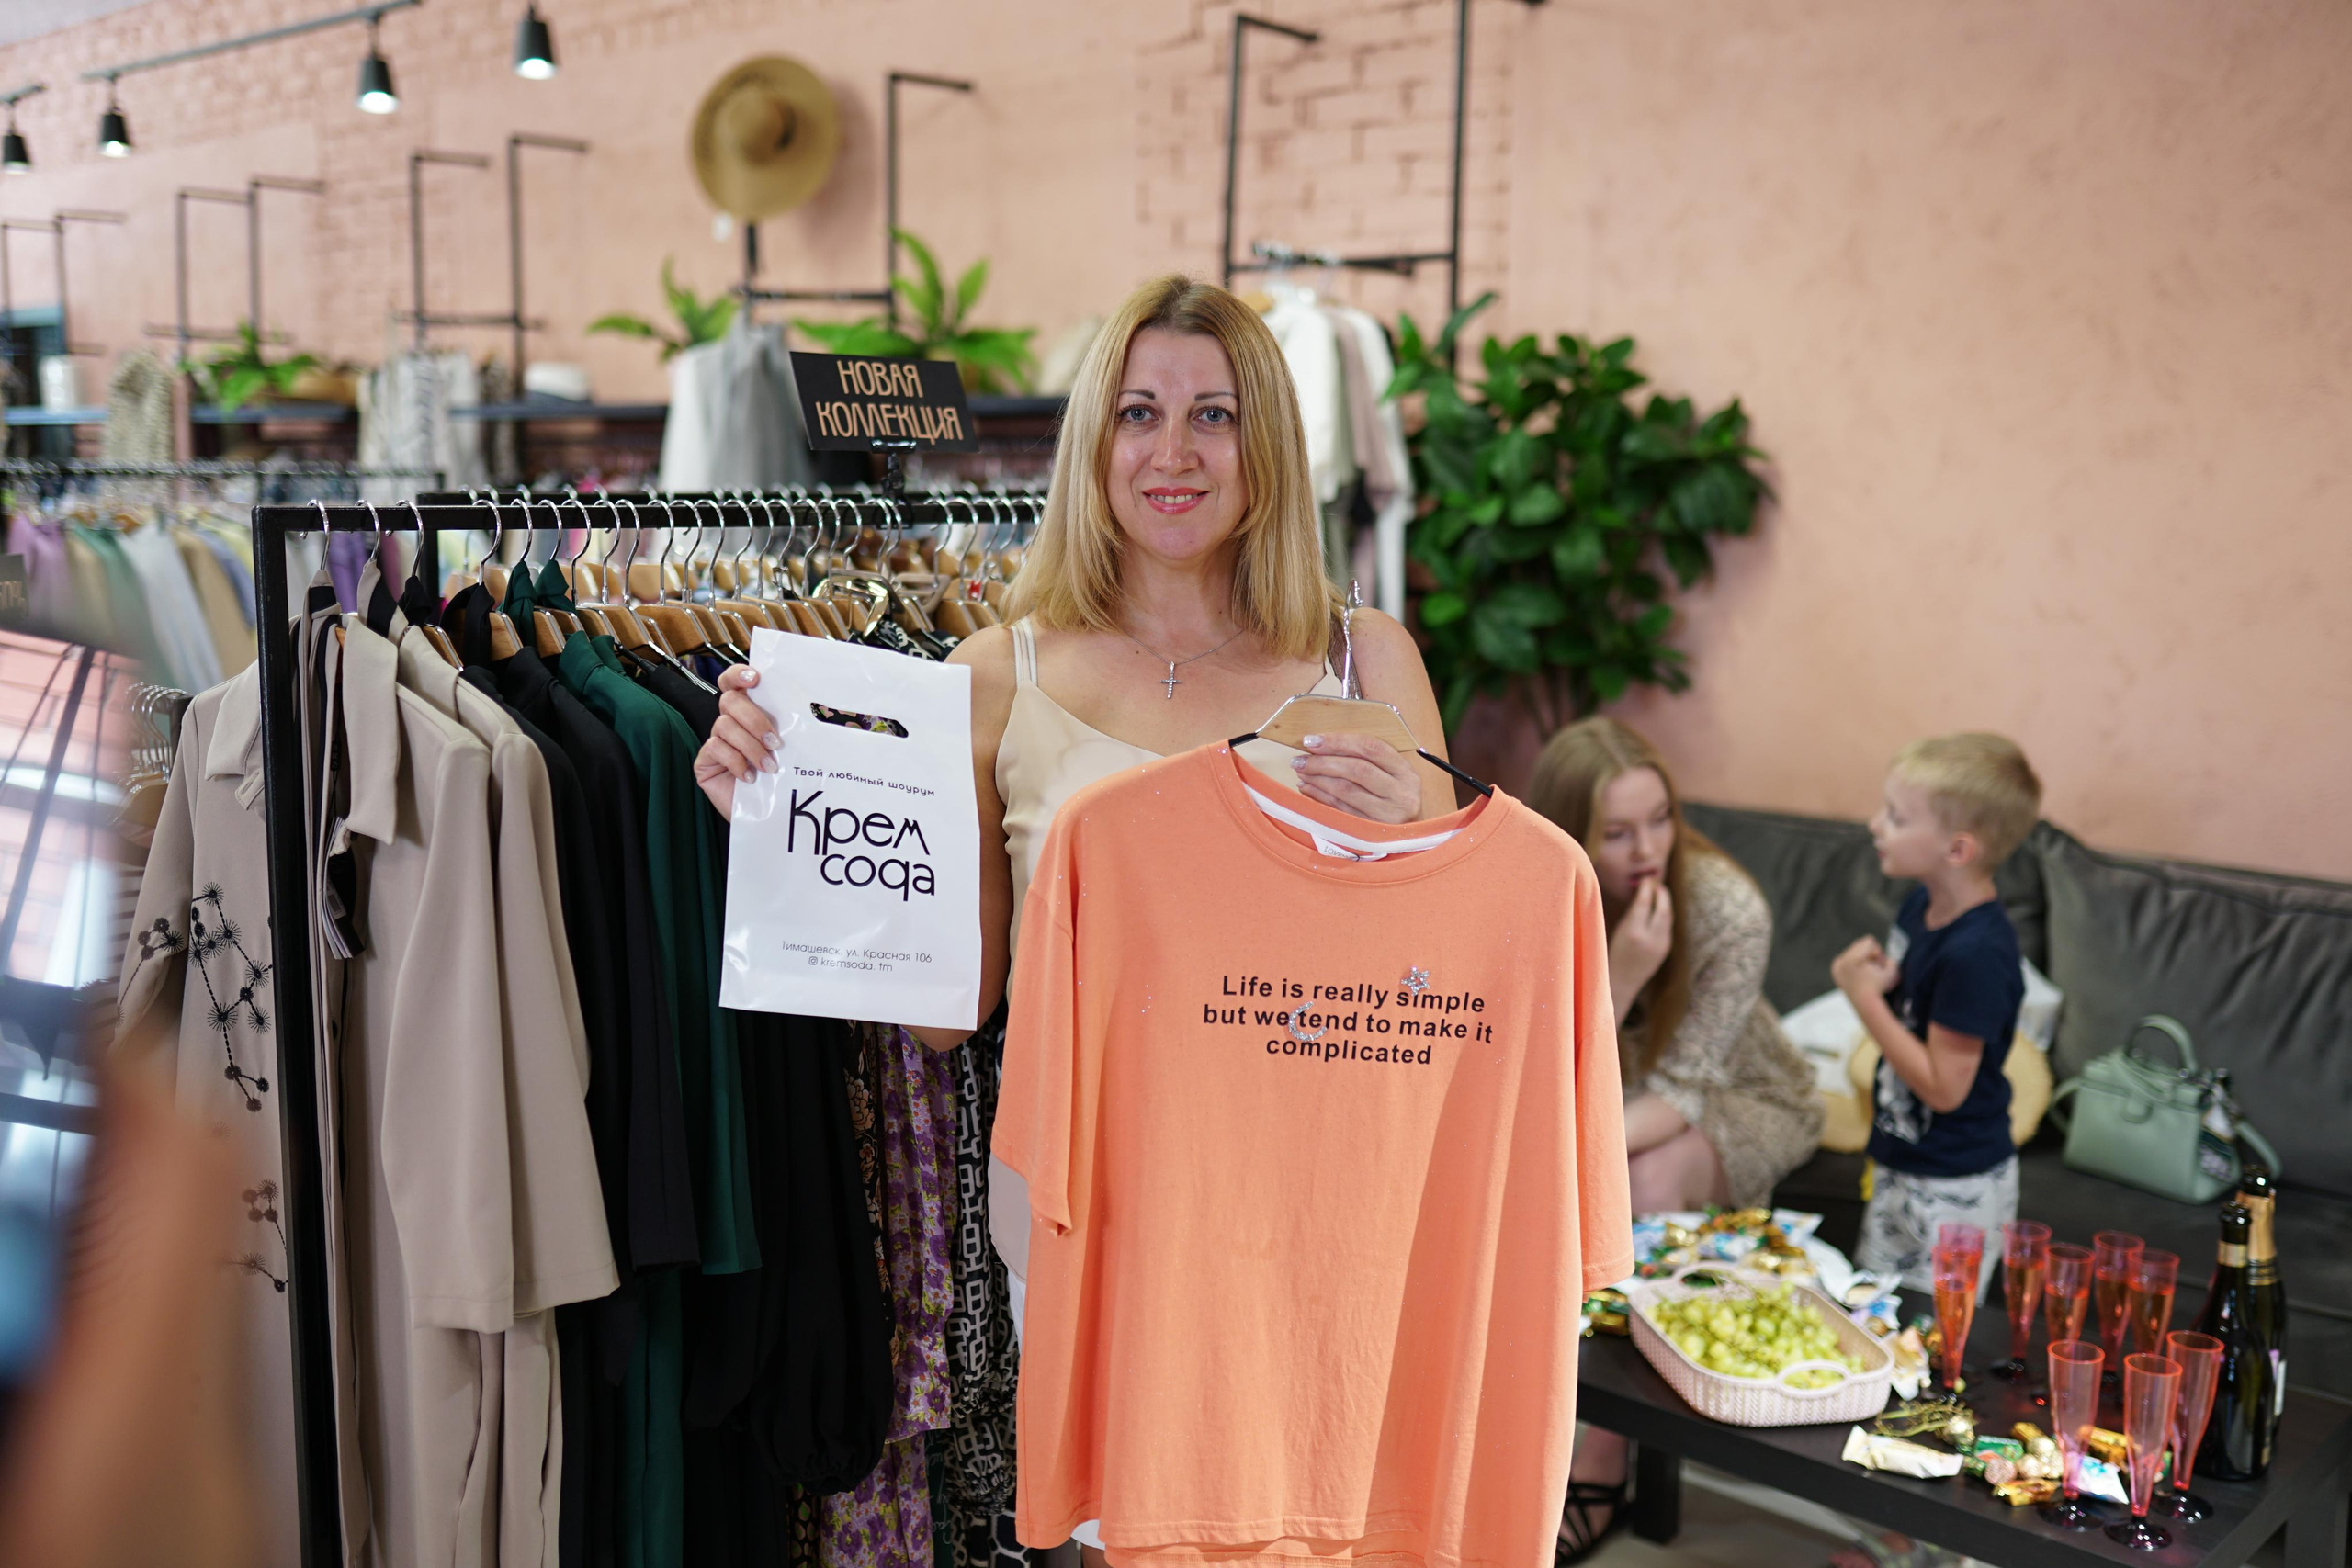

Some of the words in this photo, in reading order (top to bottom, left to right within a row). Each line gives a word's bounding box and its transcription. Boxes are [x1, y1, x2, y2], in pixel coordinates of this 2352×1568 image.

[837, 360, 923, 398] НОВАЯ
[815, 401, 964, 446] КОЛЛЕКЦИЯ
[793, 767, 823, 777] Твой
[828, 772, 884, 786] любимый
[888, 781, 935, 797] шоурум
[787, 789, 931, 856] Крем
[846, 949, 860, 958] ул.
[863, 949, 911, 962] Красная
[915, 953, 933, 964] 106
[1223, 976, 1272, 997] Life
[1282, 978, 1303, 998] is
[1313, 984, 1388, 1009] really
[1396, 992, 1485, 1014] simple
[1204, 1004, 1246, 1025] but
[1254, 1010, 1289, 1026] we
[1298, 1011, 1357, 1031] tend
[1366, 1014, 1391, 1033] to
[1399, 1018, 1467, 1038] make
[1476, 1022, 1493, 1043] it
[1266, 1040, 1431, 1064] complicated
